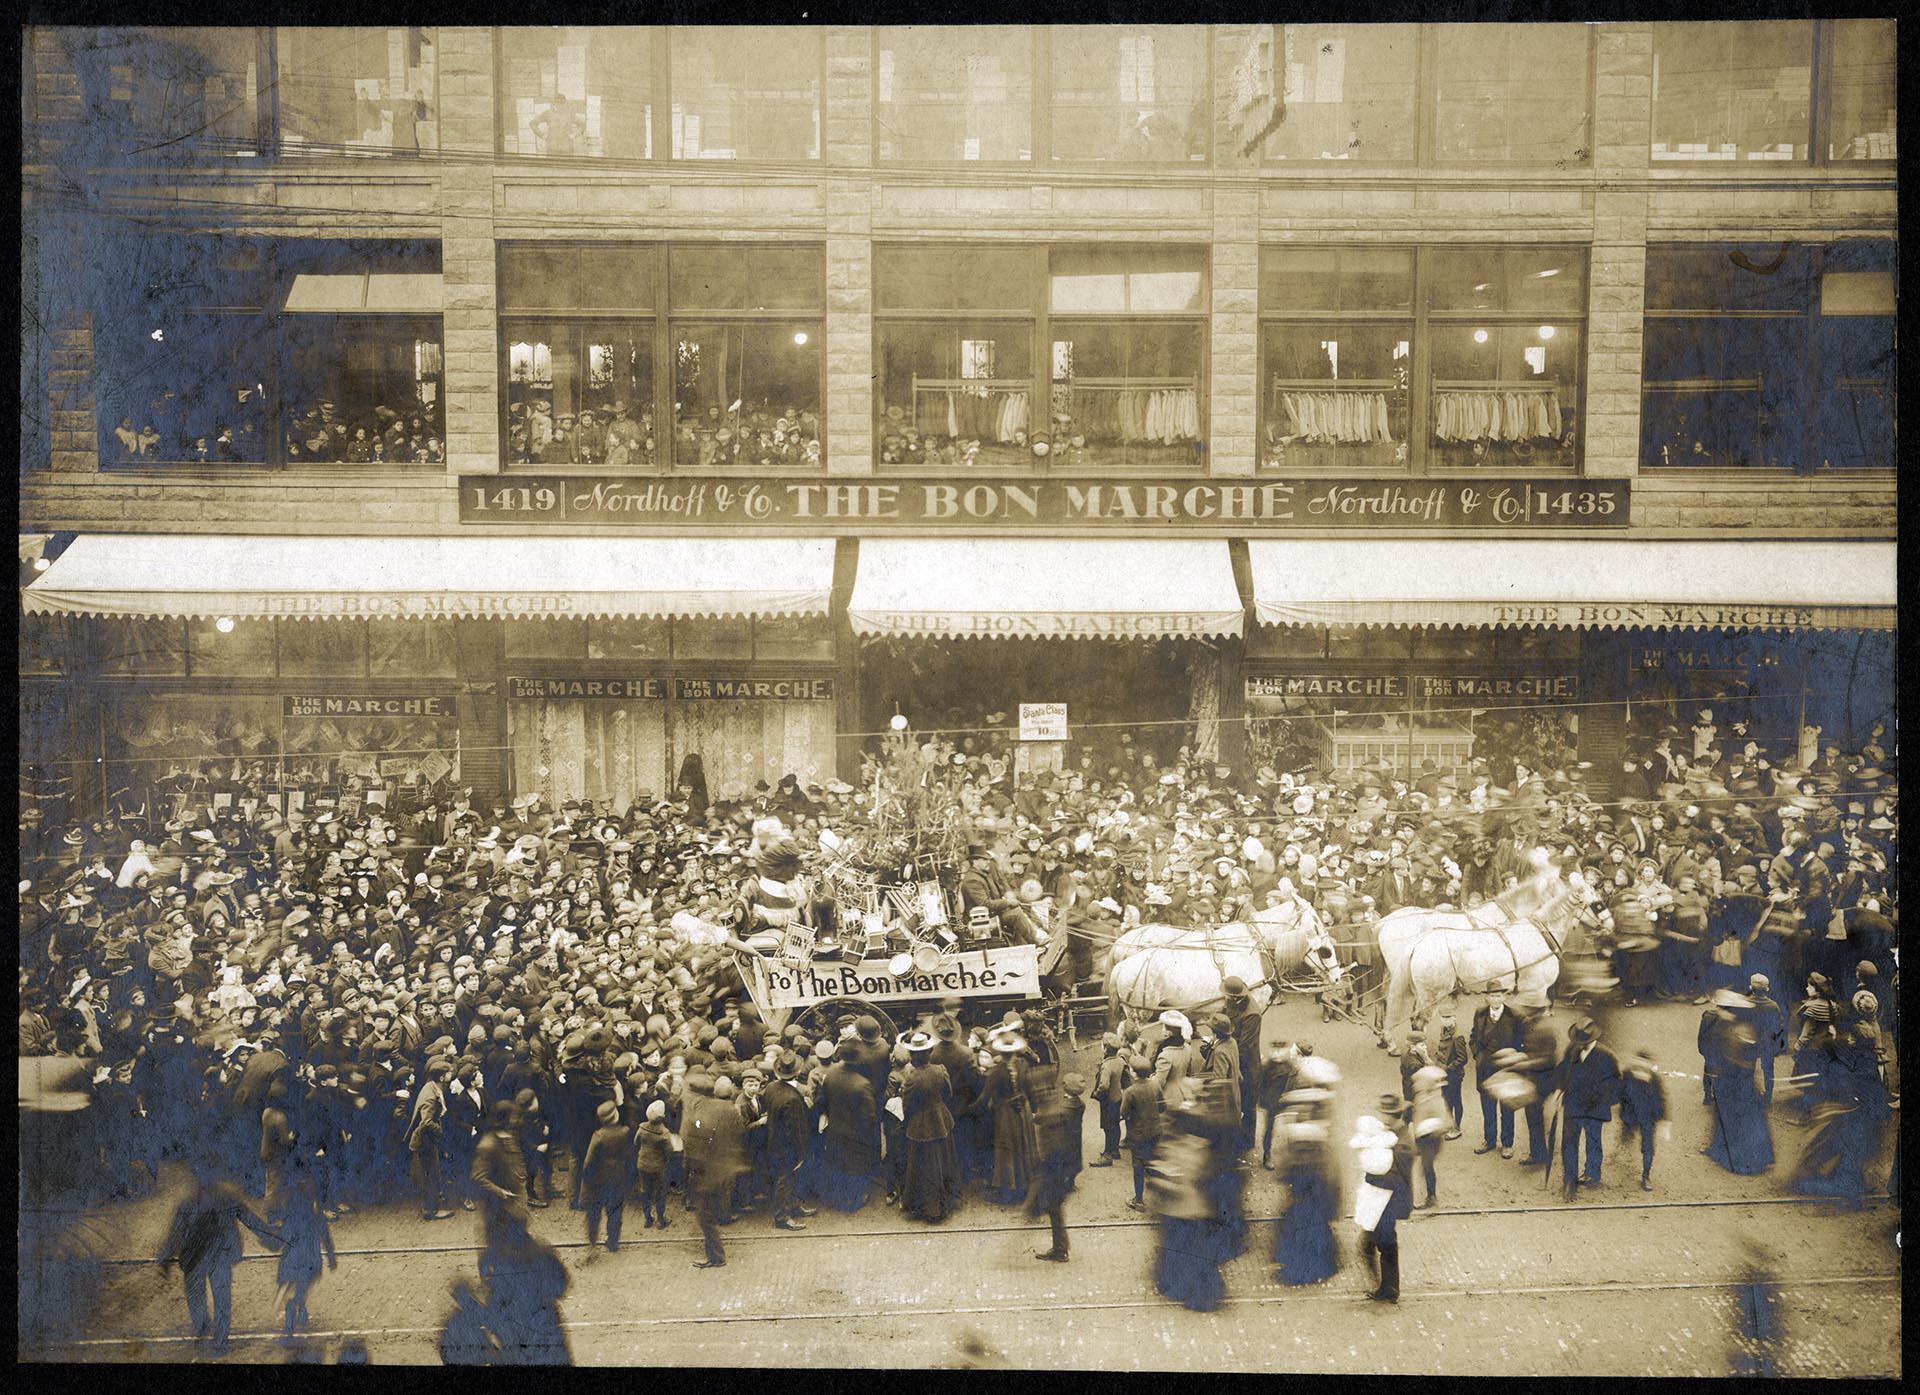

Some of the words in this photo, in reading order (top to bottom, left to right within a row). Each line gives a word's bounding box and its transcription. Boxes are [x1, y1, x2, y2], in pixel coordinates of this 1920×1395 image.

[473, 487, 556, 511] 1419
[573, 483, 706, 517] Nordhoff
[715, 484, 735, 512] &
[738, 484, 781, 520] Co.
[786, 485, 900, 518] THE
[920, 485, 1043, 518] BON
[1063, 482, 1294, 519] MARCHÉ
[1307, 486, 1446, 521] Nordhoff
[1460, 487, 1482, 514] &
[1487, 487, 1525, 523] Co.
[1536, 491, 1616, 515] 1435
[257, 597, 322, 613] THE
[1493, 606, 1559, 622] THE
[1578, 607, 1646, 622] BON
[885, 615, 951, 631] THE
[970, 615, 1039, 632] BON
[516, 678, 543, 687] THE
[684, 680, 711, 688] THE
[1254, 677, 1282, 686] THE
[1424, 678, 1451, 687] THE
[516, 688, 545, 697] BON
[683, 689, 711, 698] BON
[1255, 686, 1283, 695] BON
[1424, 687, 1451, 696] BON
[291, 696, 321, 706] THE
[291, 706, 321, 715] BON
[839, 967, 891, 996] Bon
